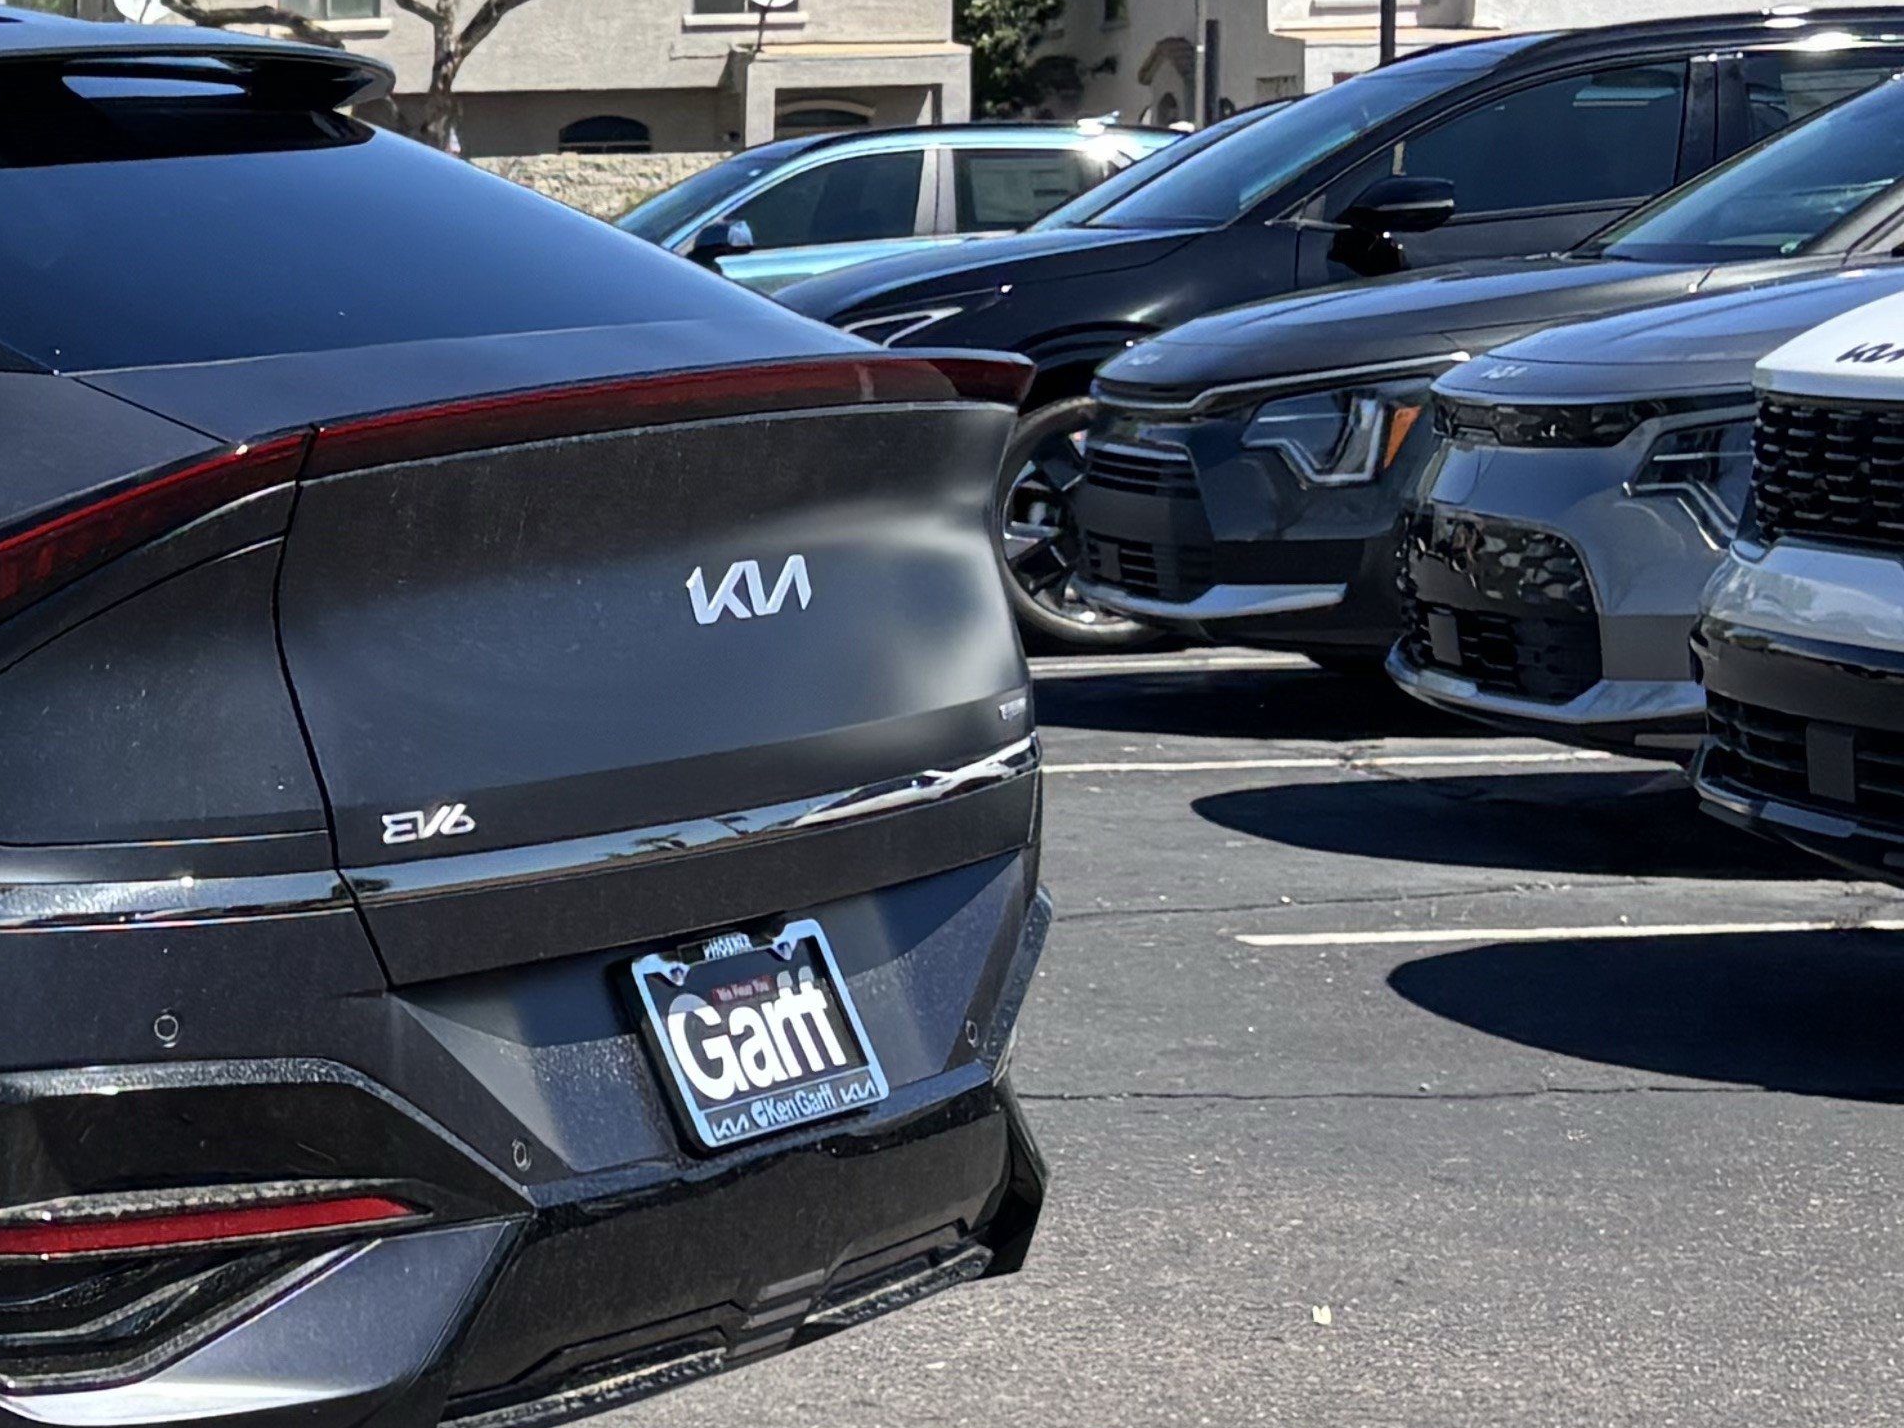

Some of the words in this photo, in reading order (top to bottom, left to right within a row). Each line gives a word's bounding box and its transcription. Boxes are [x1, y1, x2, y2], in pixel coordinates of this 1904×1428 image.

[685, 554, 812, 625] KIA
[381, 803, 476, 844] EV6
[667, 965, 848, 1100] Garff
[794, 1083, 837, 1116] Garff
